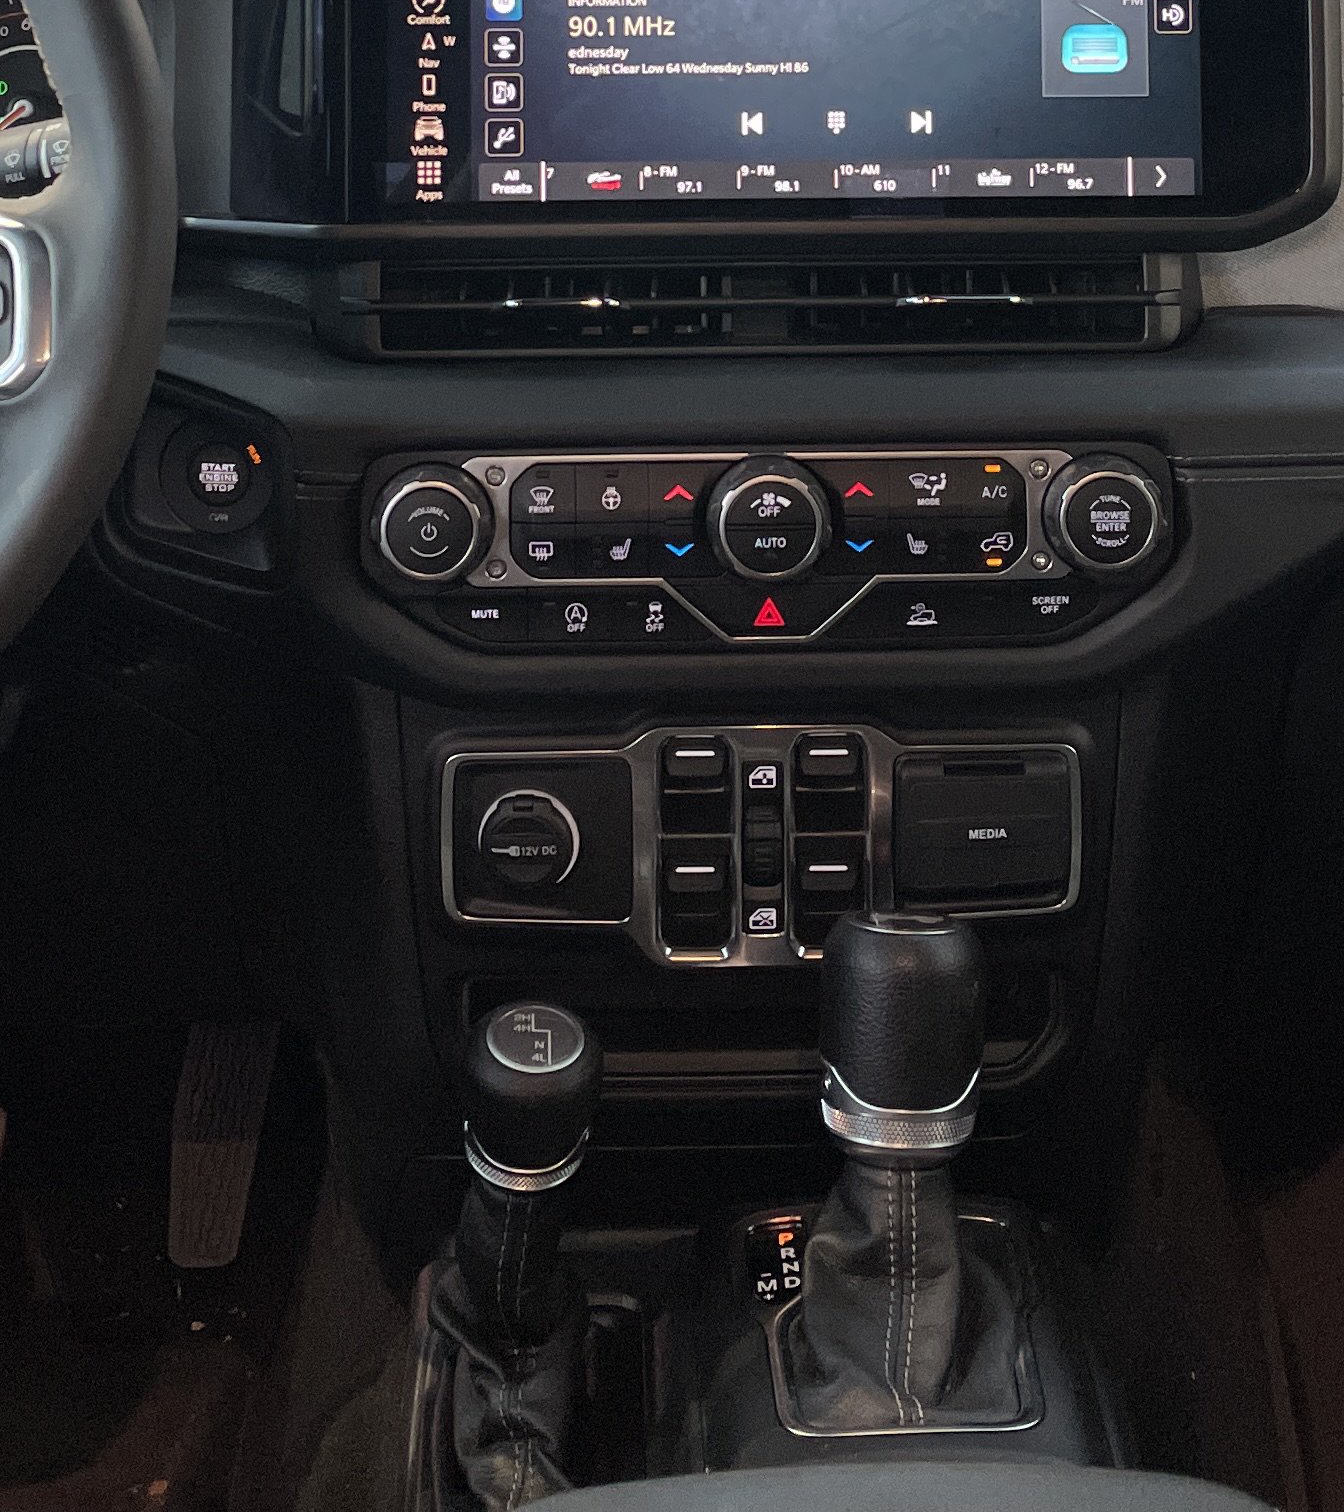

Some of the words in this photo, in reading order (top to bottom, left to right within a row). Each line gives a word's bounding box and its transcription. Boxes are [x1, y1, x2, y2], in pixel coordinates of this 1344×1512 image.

[407, 14, 451, 25] Comfort
[568, 16, 617, 37] 90.1
[624, 16, 676, 37] MHz
[443, 36, 456, 46] W
[568, 46, 629, 60] ednesday
[417, 58, 440, 68] Nav
[568, 63, 610, 76] Tonight
[612, 63, 640, 74] Clear
[642, 63, 664, 74] Low
[666, 63, 680, 73] 64
[682, 63, 743, 76] Wednesday
[745, 62, 779, 76] Sunny
[794, 62, 809, 73] 86
[412, 101, 446, 112] Phone
[410, 146, 448, 156] Vehicle
[504, 169, 520, 180] All
[547, 167, 554, 179] 7
[937, 164, 950, 176] 11
[491, 183, 533, 195] Presets
[677, 181, 702, 193] 97.1
[774, 180, 799, 193] 98.1
[873, 179, 896, 191] 610
[1067, 178, 1094, 190] 96.7
[415, 190, 443, 202] Apps
[201, 463, 236, 471] START
[199, 473, 238, 482] ENGINE
[205, 484, 235, 492] STOP
[981, 486, 1007, 499] A/C
[917, 498, 941, 506] MODE
[528, 505, 554, 514] FRONT
[758, 506, 781, 517] OFF
[1090, 510, 1130, 520] BROWSE
[1095, 523, 1127, 531] ENTER
[754, 537, 786, 549] AUTO
[1096, 537, 1126, 547] SCROLL
[1032, 596, 1069, 605] SCREEN
[471, 609, 499, 619] MUTE
[1041, 606, 1059, 614] OFF
[567, 623, 587, 633] OFF
[645, 623, 664, 632] OFF
[968, 828, 1007, 839] MEDIA
[521, 846, 540, 856] 12V
[541, 845, 557, 856] DC
[513, 1023, 531, 1032] 4H
[534, 1040, 545, 1049] N
[531, 1053, 545, 1062] 4L
[778, 1232, 794, 1246] P
[780, 1247, 796, 1259] R
[782, 1261, 800, 1274] N
[757, 1279, 778, 1293] M
[784, 1276, 801, 1289] D
